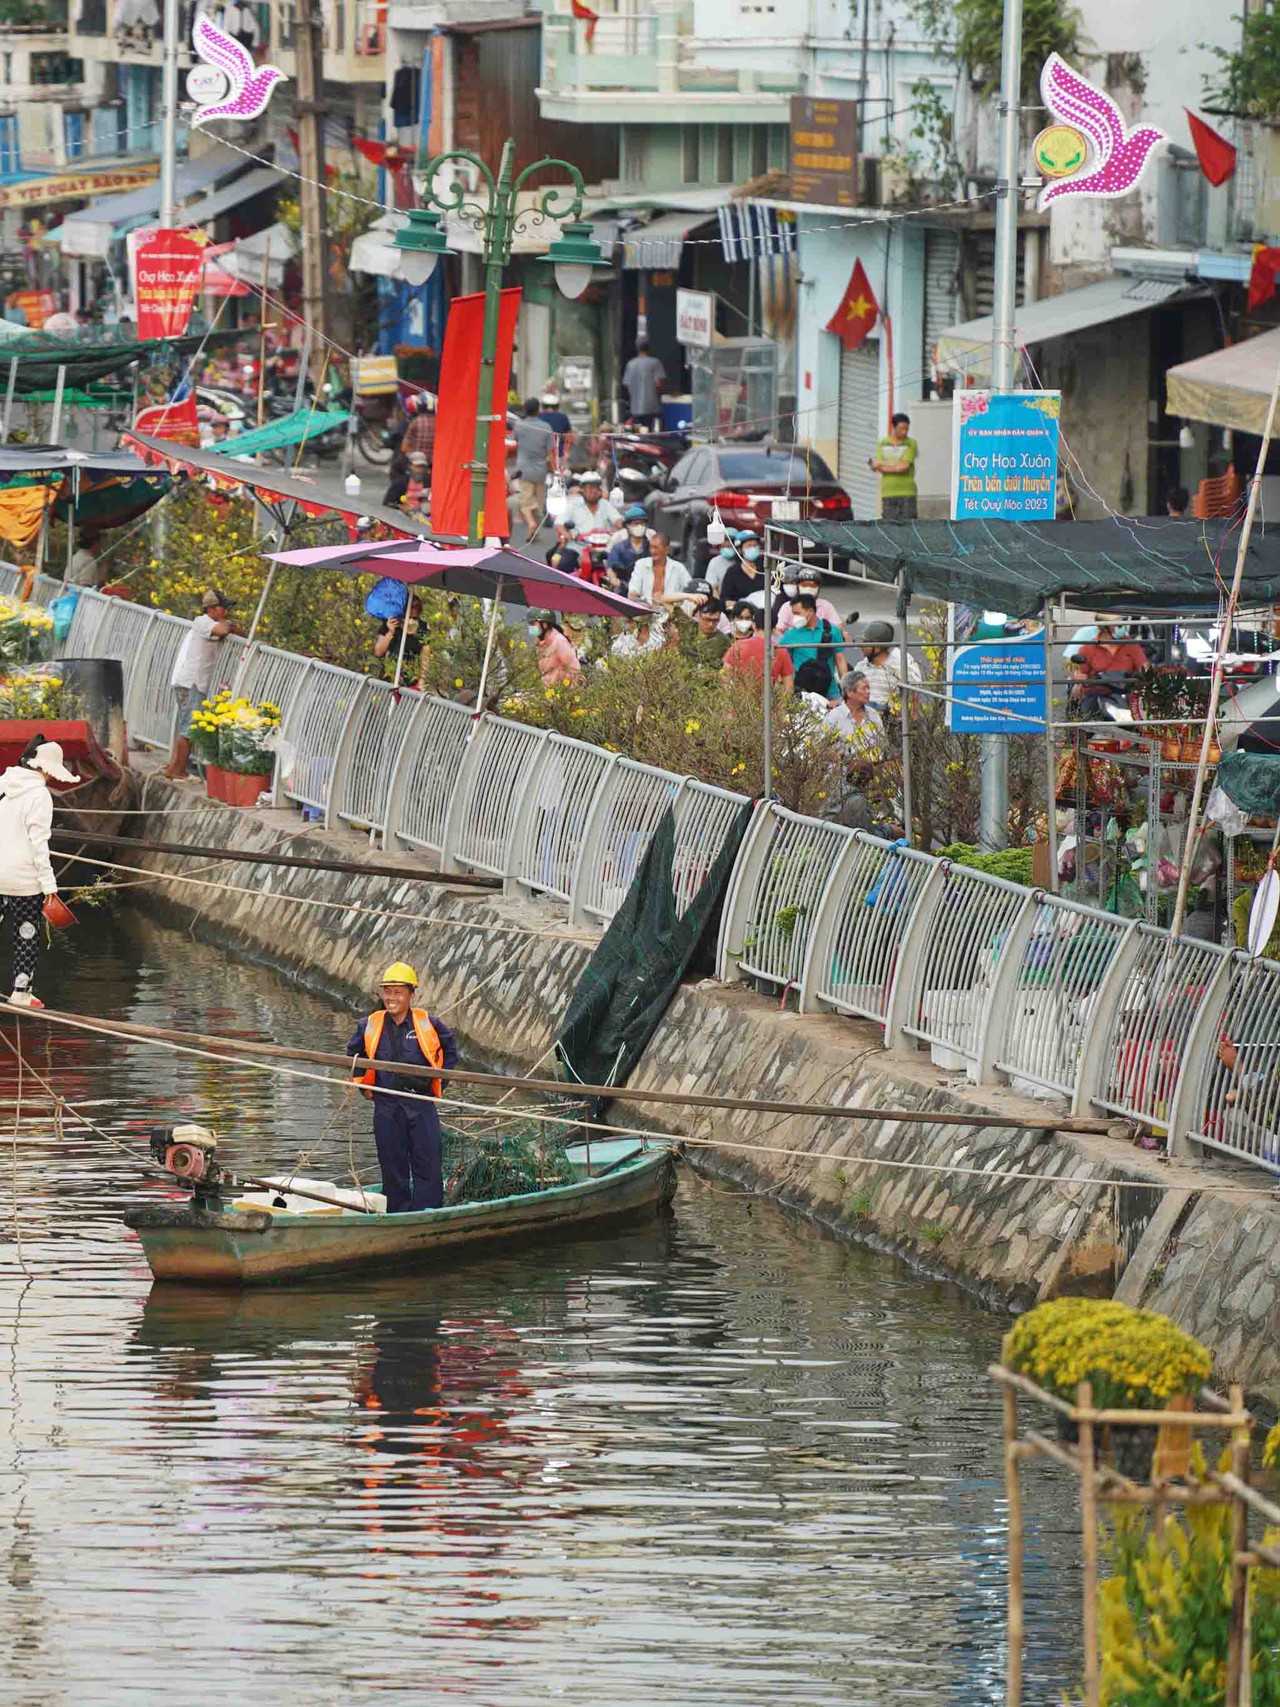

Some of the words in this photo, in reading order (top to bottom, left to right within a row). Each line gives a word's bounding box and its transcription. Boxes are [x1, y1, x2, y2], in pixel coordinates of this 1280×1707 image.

[964, 452, 988, 470] Chợ
[992, 453, 1016, 468] Hoa
[1020, 453, 1051, 468] Xuân
[985, 472, 1001, 491] bến
[1004, 475, 1021, 491] dưới
[963, 496, 978, 510] Tết
[1004, 498, 1022, 510] Mão
[1025, 498, 1048, 510] 2023
